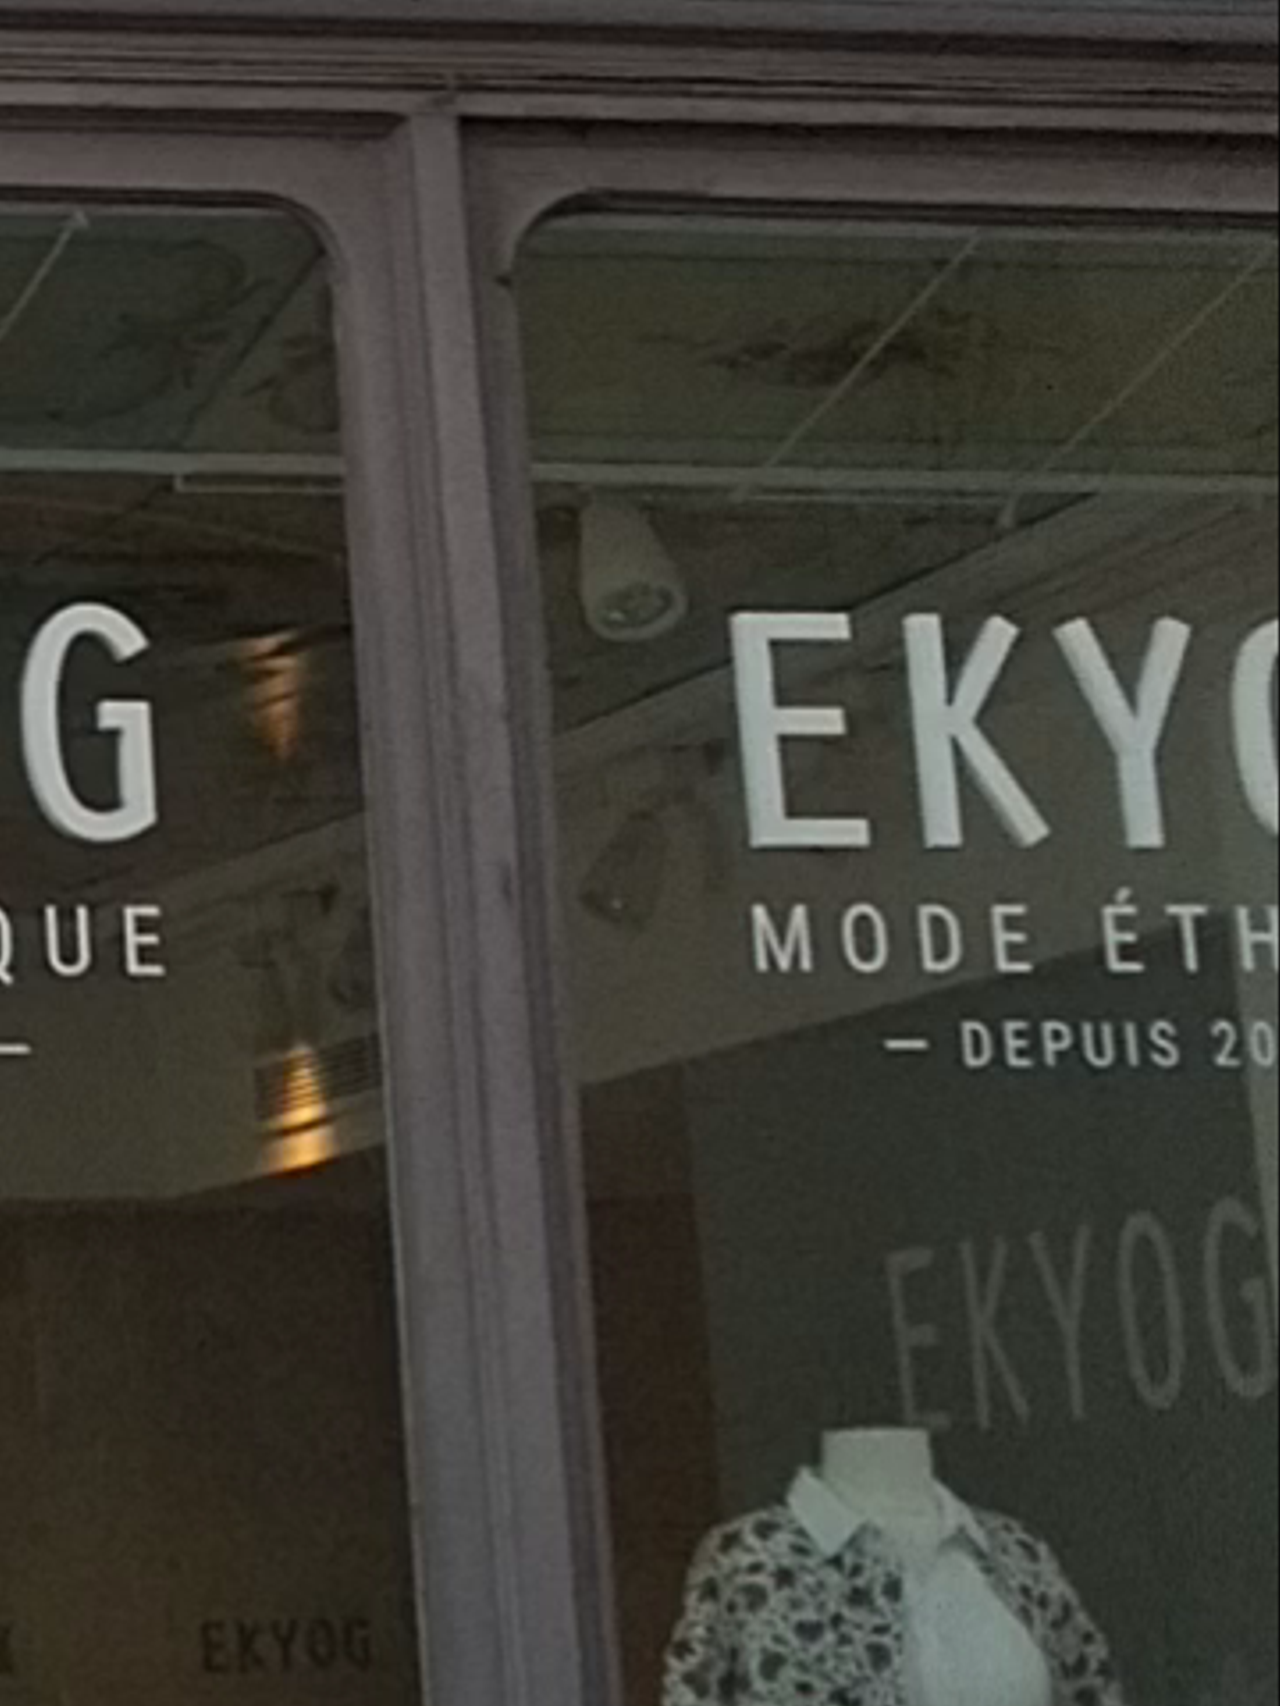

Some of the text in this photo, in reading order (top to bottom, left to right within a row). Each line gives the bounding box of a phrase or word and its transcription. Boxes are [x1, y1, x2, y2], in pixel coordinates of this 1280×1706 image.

[750, 903, 1034, 974] MODE
[961, 1020, 1180, 1068] DEPUIS
[200, 1618, 373, 1676] EKYOG
